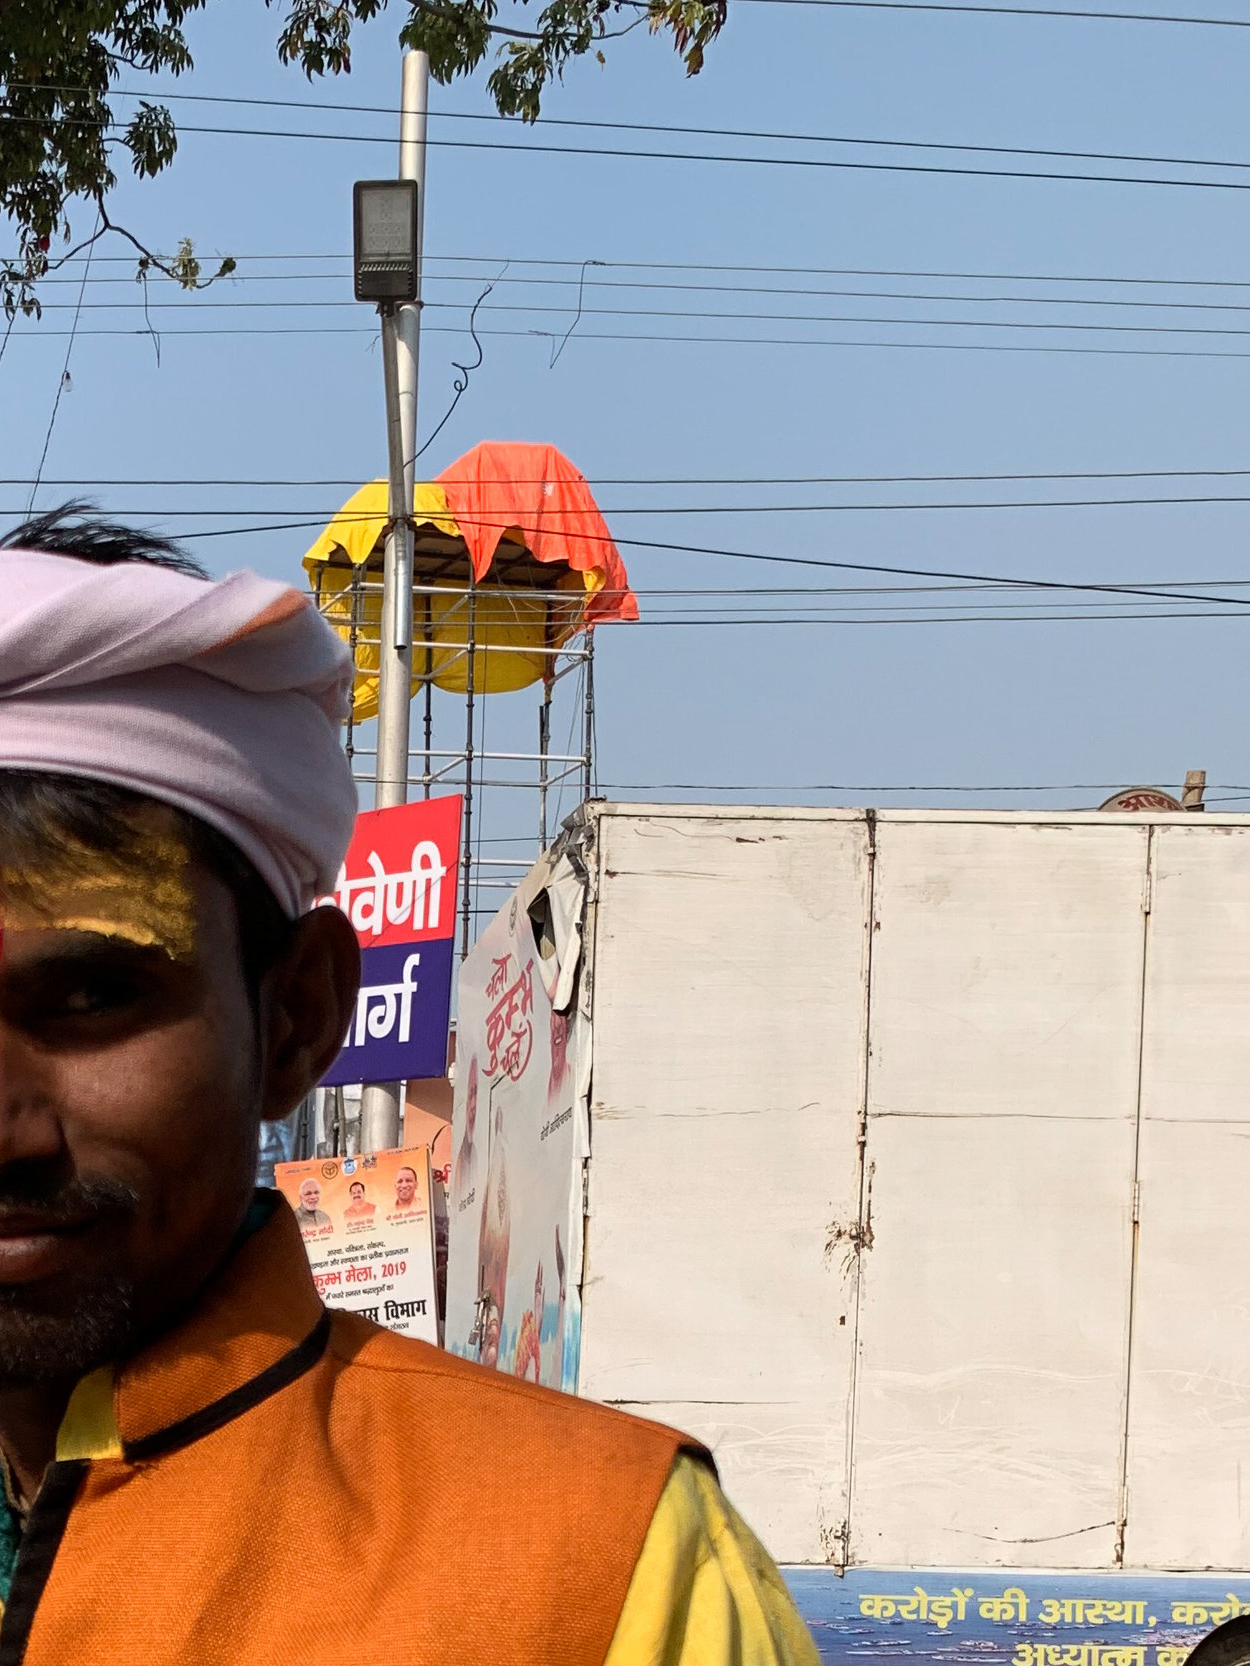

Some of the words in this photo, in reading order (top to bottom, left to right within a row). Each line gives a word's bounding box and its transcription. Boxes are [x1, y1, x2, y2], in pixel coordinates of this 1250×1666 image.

[345, 1264, 377, 1283] मेला,
[381, 1261, 407, 1278] 2019
[385, 1299, 427, 1321] विभाग
[858, 1587, 974, 1629] करोड़ों
[977, 1587, 1031, 1622] की
[1038, 1599, 1157, 1628] आस्था,
[1171, 1593, 1250, 1626] करो
